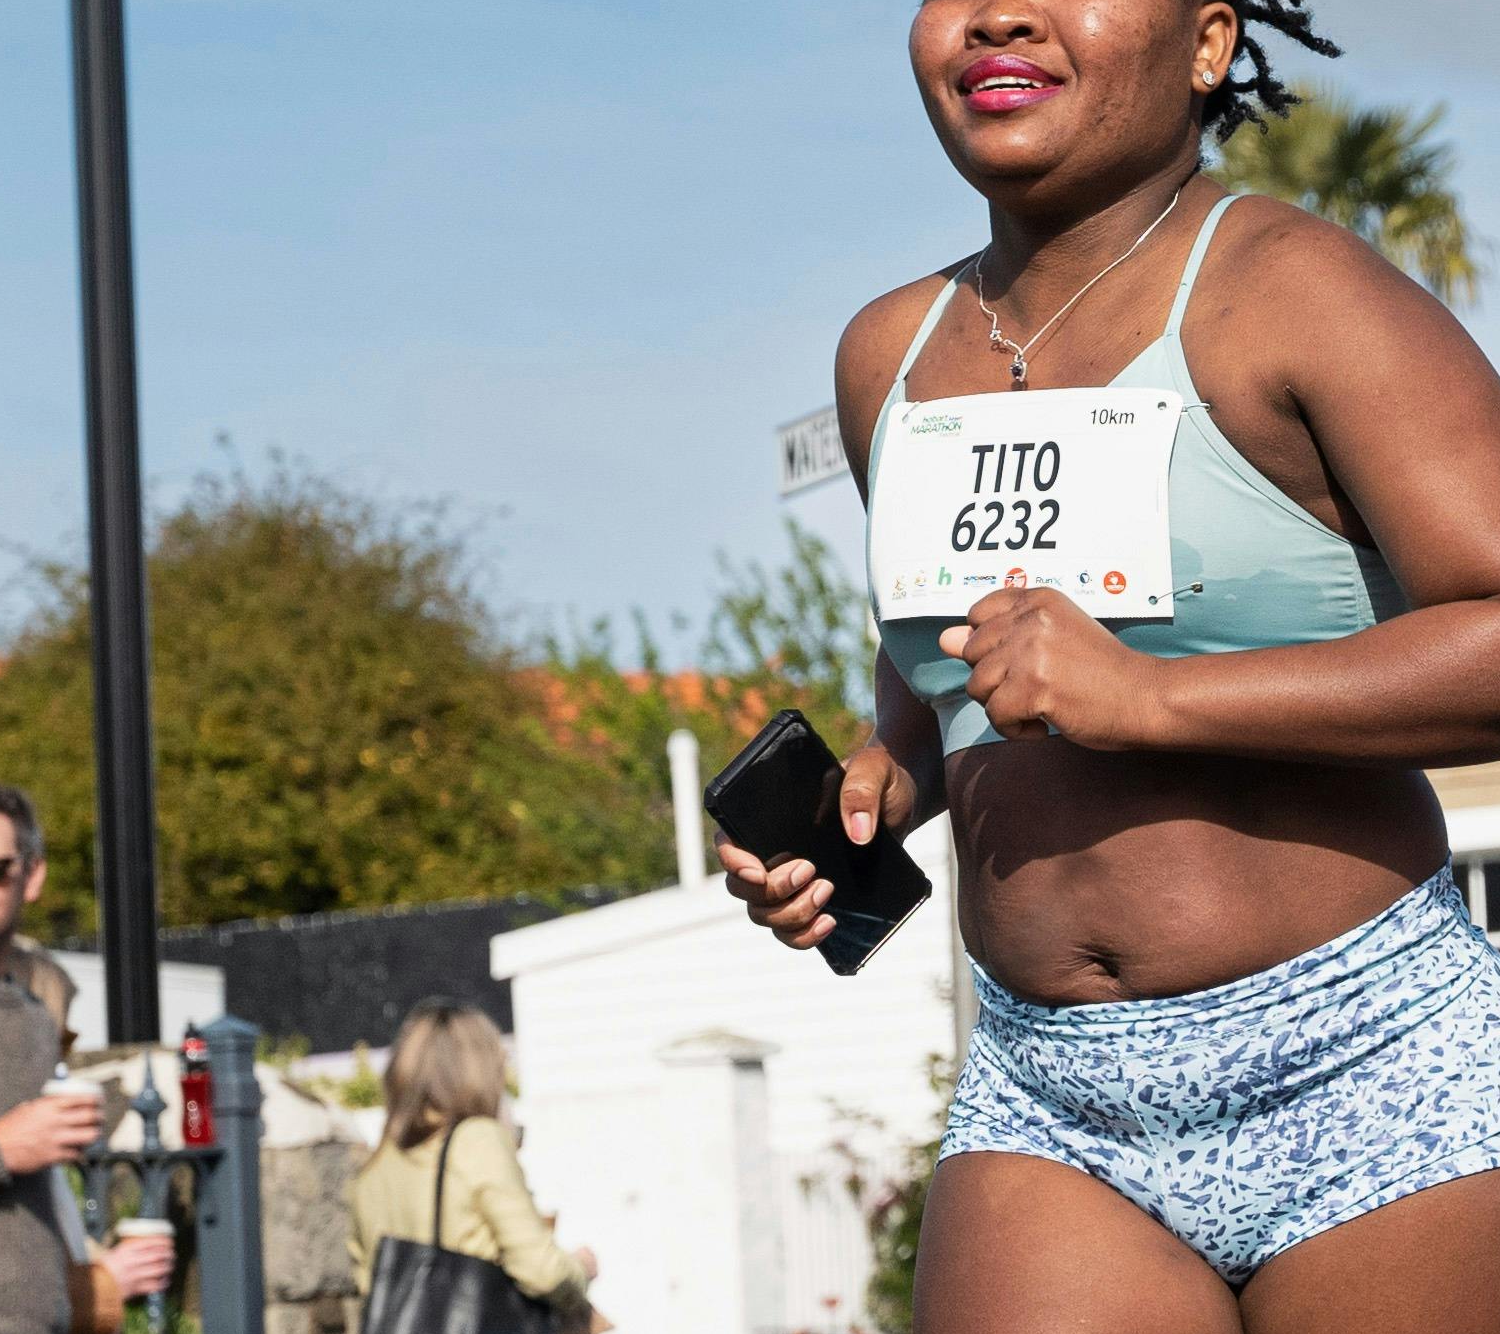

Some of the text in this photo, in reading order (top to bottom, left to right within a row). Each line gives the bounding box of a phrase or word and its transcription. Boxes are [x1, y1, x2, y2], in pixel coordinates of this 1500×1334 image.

[1091, 409, 1135, 425] 10km
[971, 441, 1060, 493] TITO
[951, 498, 1060, 552] 6232
